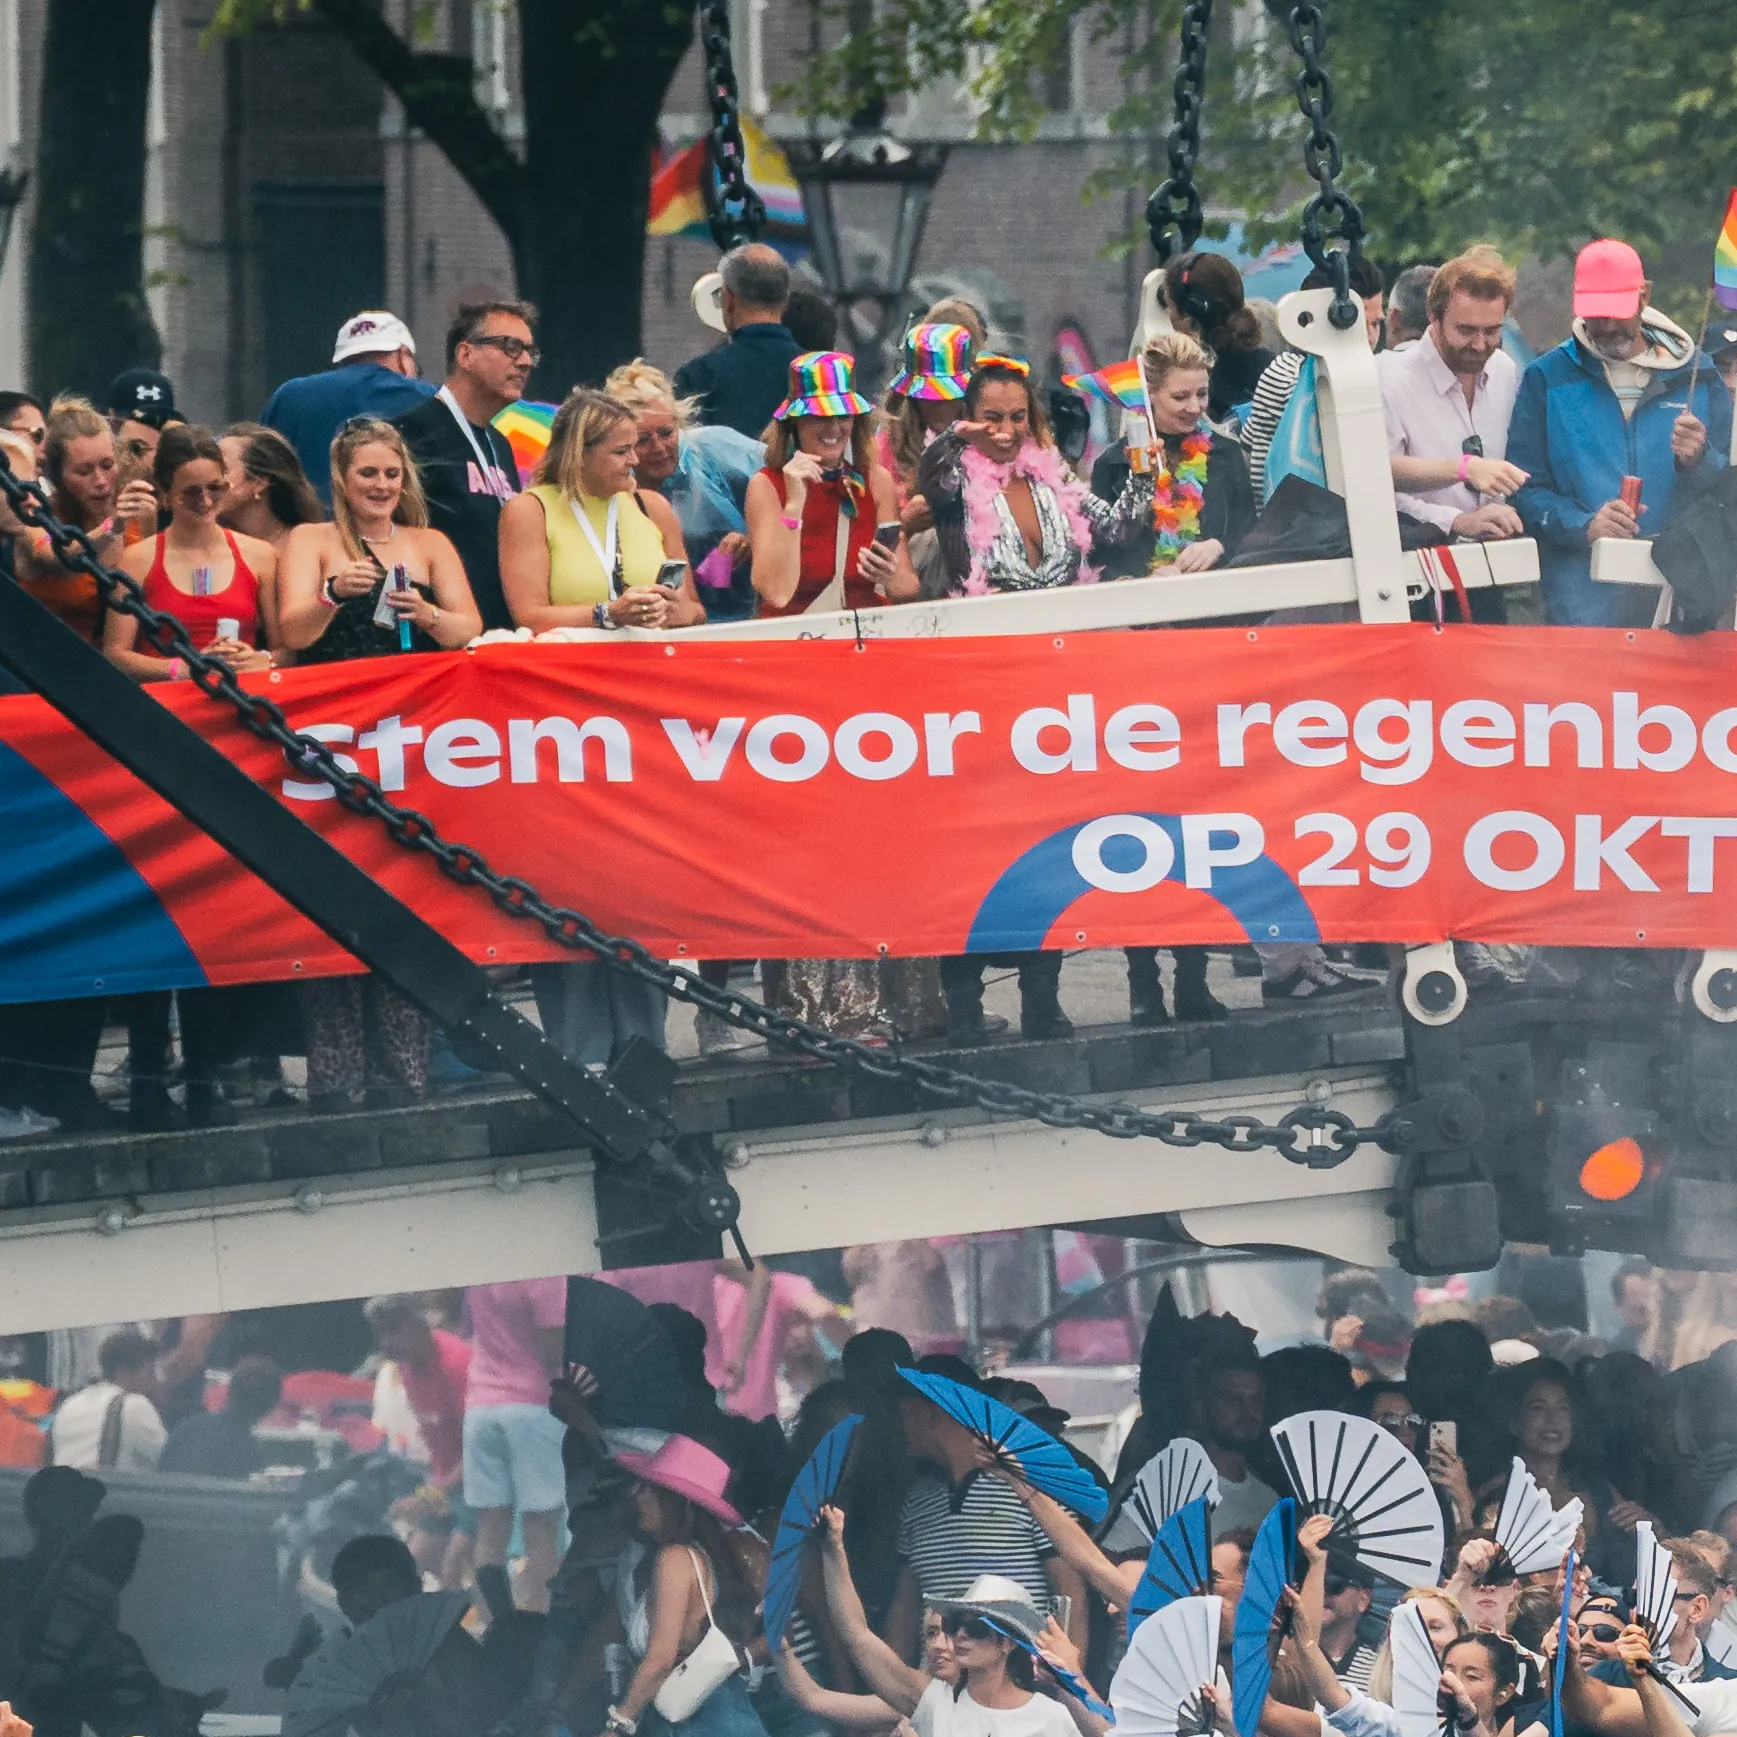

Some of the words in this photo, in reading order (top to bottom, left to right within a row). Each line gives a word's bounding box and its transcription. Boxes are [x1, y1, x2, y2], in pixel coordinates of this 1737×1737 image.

[281, 711, 633, 802] stem
[661, 708, 982, 783] voor
[1010, 694, 1181, 773] de
[1072, 812, 1265, 893] OP
[1294, 812, 1432, 888] 29
